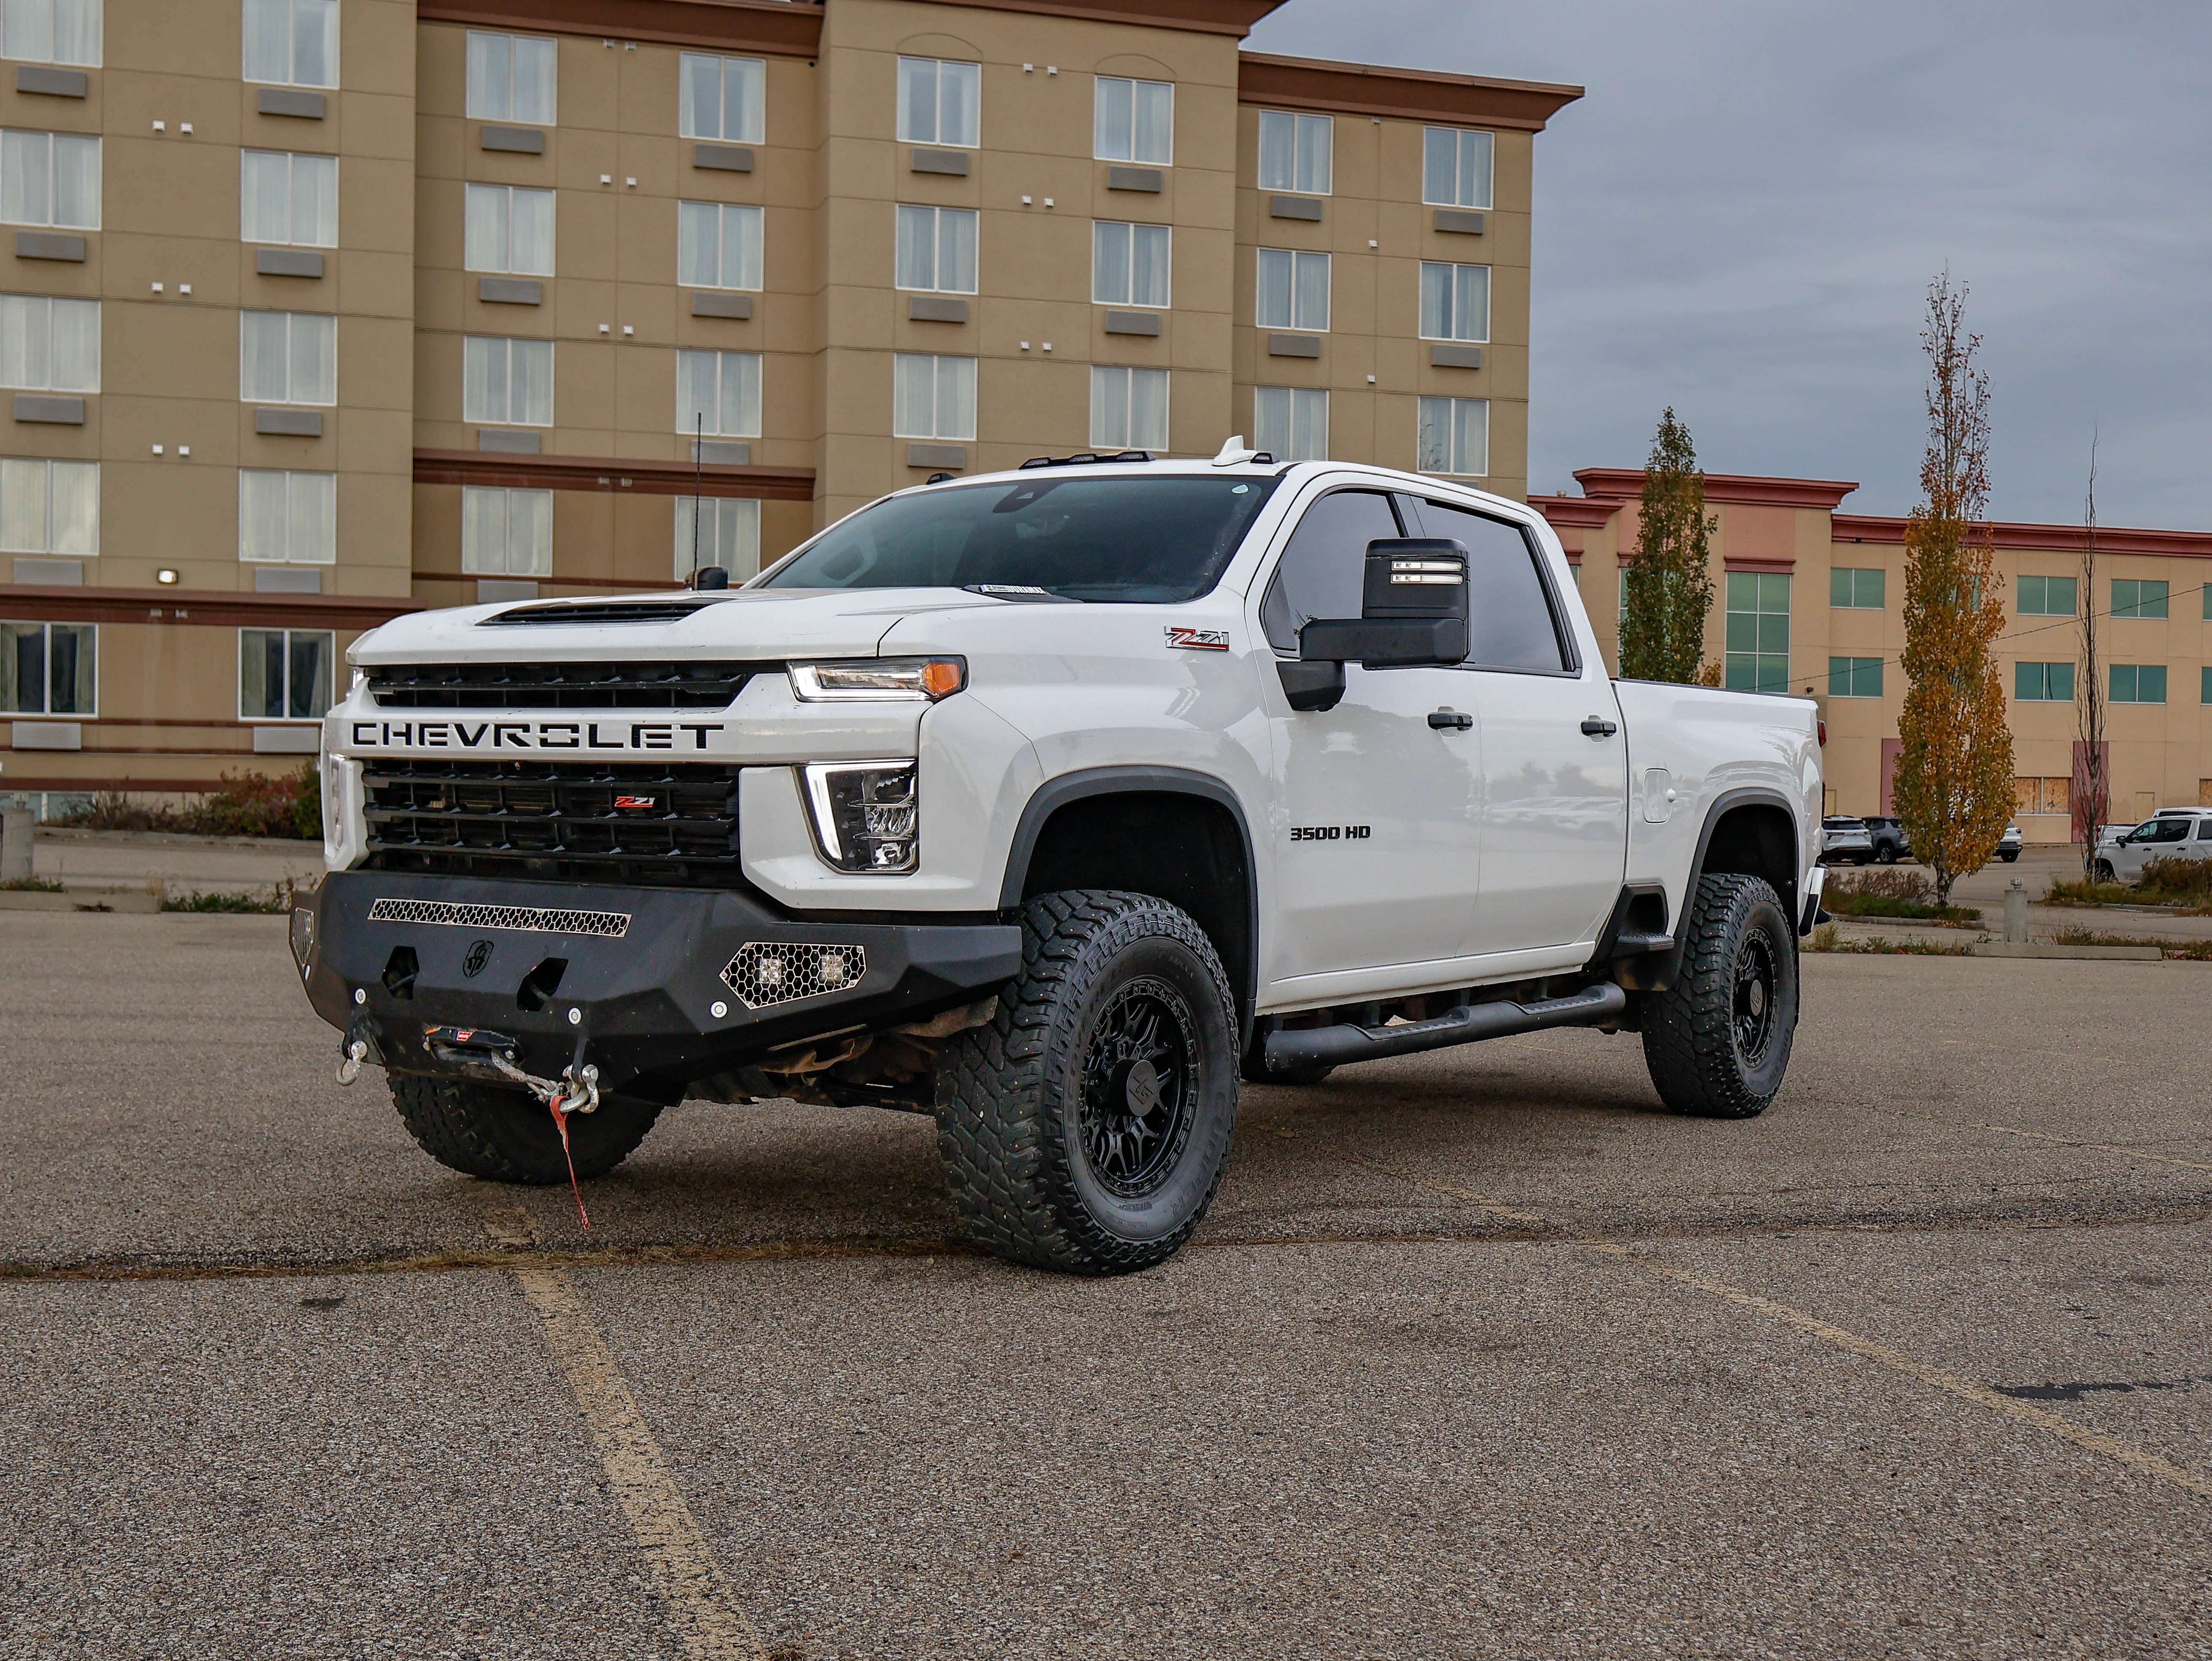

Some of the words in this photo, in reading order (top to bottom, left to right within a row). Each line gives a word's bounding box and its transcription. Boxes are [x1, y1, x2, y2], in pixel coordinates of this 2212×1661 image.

[1007, 585, 1046, 594] DURAMAX
[1164, 626, 1229, 652] Z71
[352, 722, 725, 750] CHEVROLET
[614, 796, 655, 807] Z71
[1291, 827, 1340, 841] 3500
[1345, 826, 1370, 839] HD
